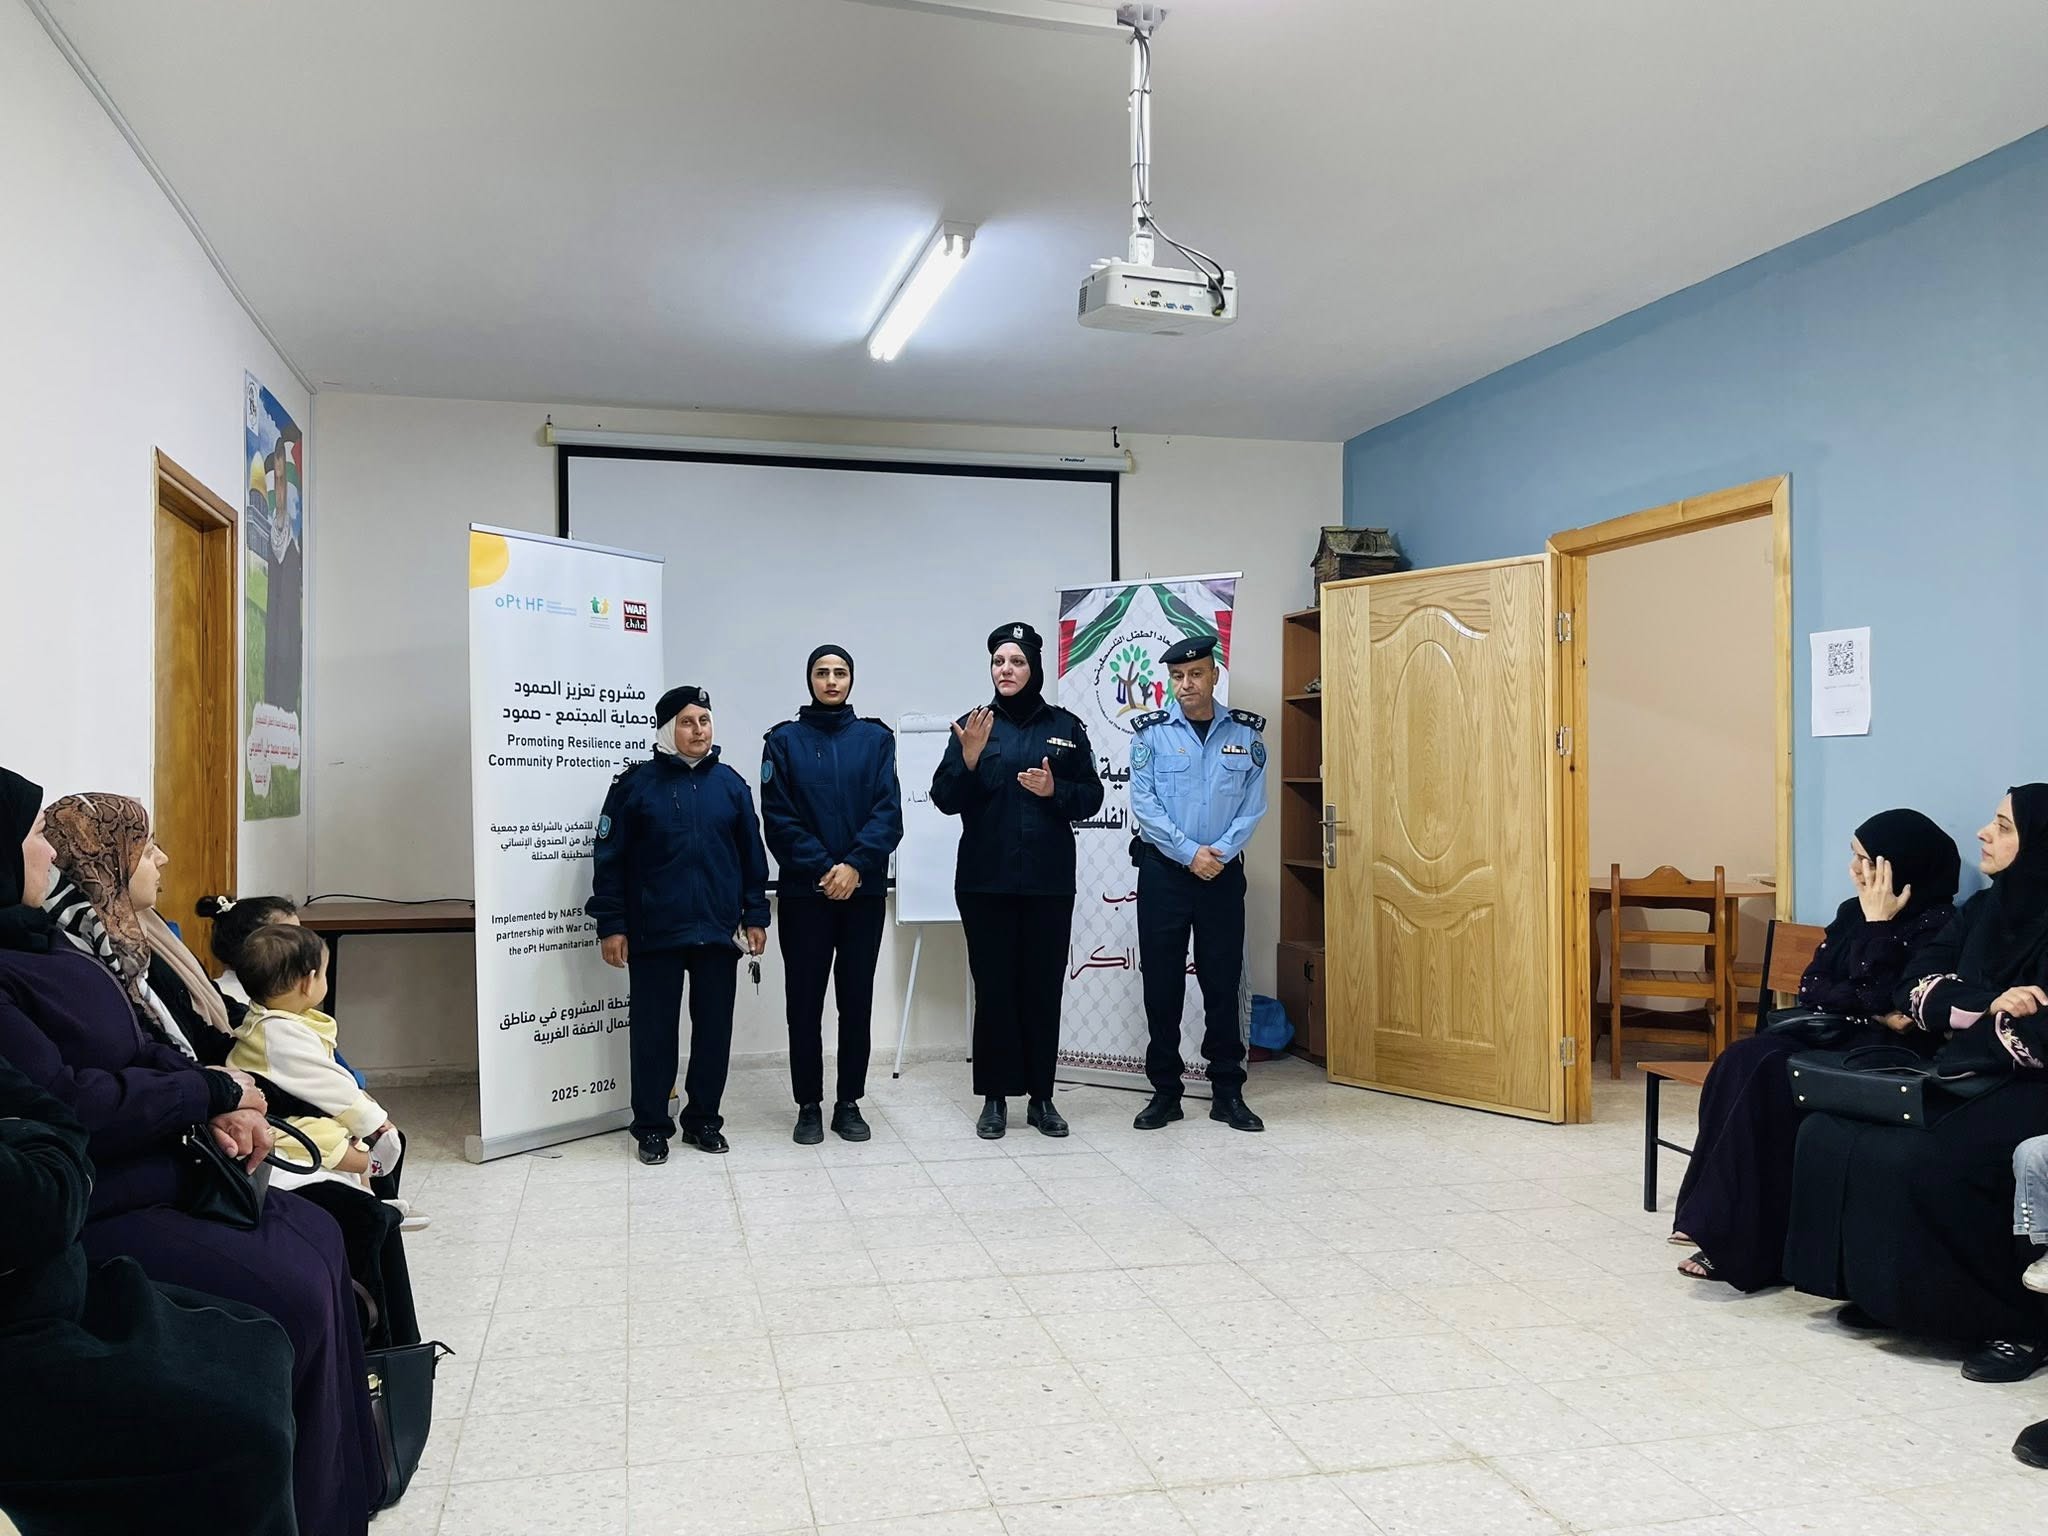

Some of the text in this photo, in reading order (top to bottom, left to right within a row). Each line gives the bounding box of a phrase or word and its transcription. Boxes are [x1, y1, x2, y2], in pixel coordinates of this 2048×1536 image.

[495, 594, 521, 610] oPt
[525, 596, 544, 612] HF
[624, 603, 646, 616] WAR
[625, 619, 646, 630] child
[1126, 630, 1157, 642] الطفل
[514, 680, 646, 703] مشروع تعزيز الصمود
[503, 708, 541, 723] صمود
[556, 708, 606, 726] المجتمع
[610, 709, 657, 728] وحماية
[507, 734, 646, 750] Promoting Resilience and
[488, 754, 553, 770] Community
[556, 755, 611, 768] Protection
[490, 823, 518, 835] جمعية
[519, 825, 530, 834] مع
[531, 821, 562, 833] بالشراكة
[564, 821, 593, 833] للتمكين
[534, 836, 567, 848] الصندوق
[569, 837, 580, 847] من
[491, 907, 582, 925] Implemented by NAFS
[496, 927, 544, 942] partnership
[546, 925, 564, 935] with
[565, 924, 581, 933] War
[509, 946, 522, 956] the
[523, 944, 537, 954] oPt
[539, 939, 594, 952] Humanitarian
[539, 1007, 557, 1027] في
[560, 999, 604, 1020] المشروع
[499, 1011, 536, 1031] مناطق
[572, 1020, 603, 1035] الضفة
[533, 1025, 569, 1045] الغربية
[551, 1085, 579, 1102] 2025
[590, 1078, 616, 1094] 2026
